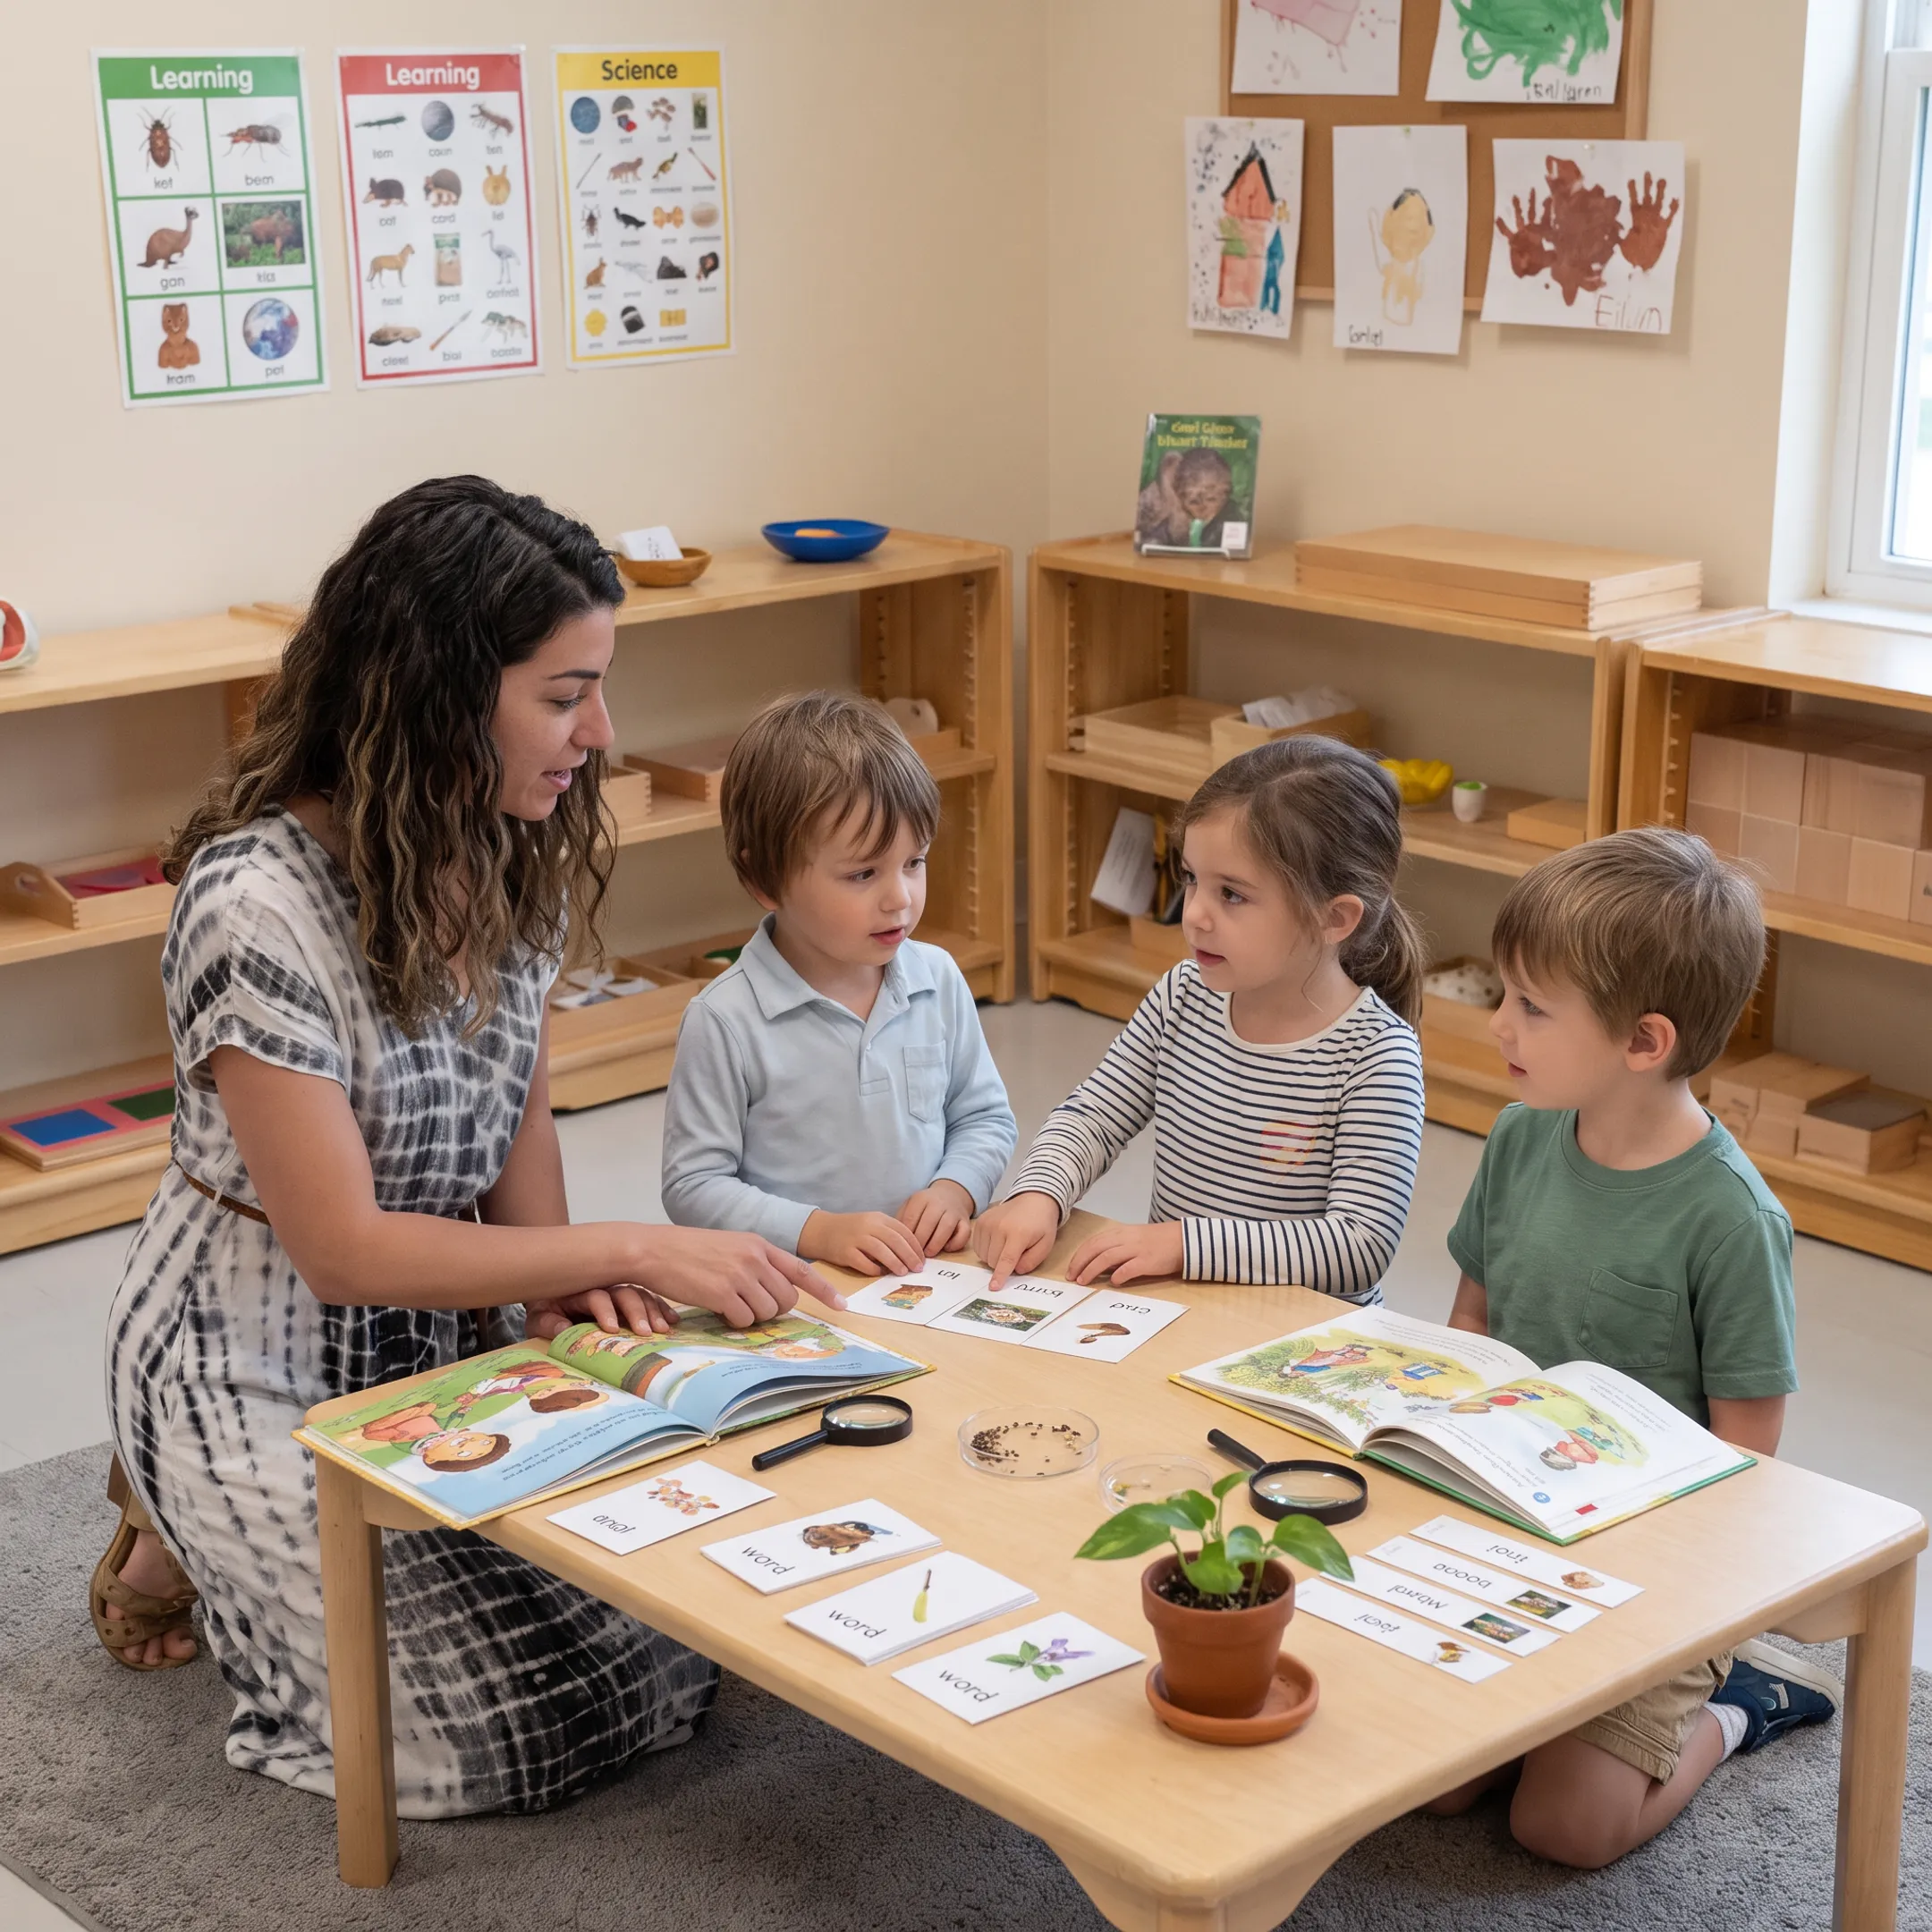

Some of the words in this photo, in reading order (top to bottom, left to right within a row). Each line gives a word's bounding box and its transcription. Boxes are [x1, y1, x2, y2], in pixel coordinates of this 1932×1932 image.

[149, 64, 254, 95] Learning
[386, 62, 480, 90] Learning
[601, 59, 678, 81] Science
[741, 1546, 796, 1576] word
[828, 1608, 887, 1640] word
[938, 1669, 1000, 1703] word
